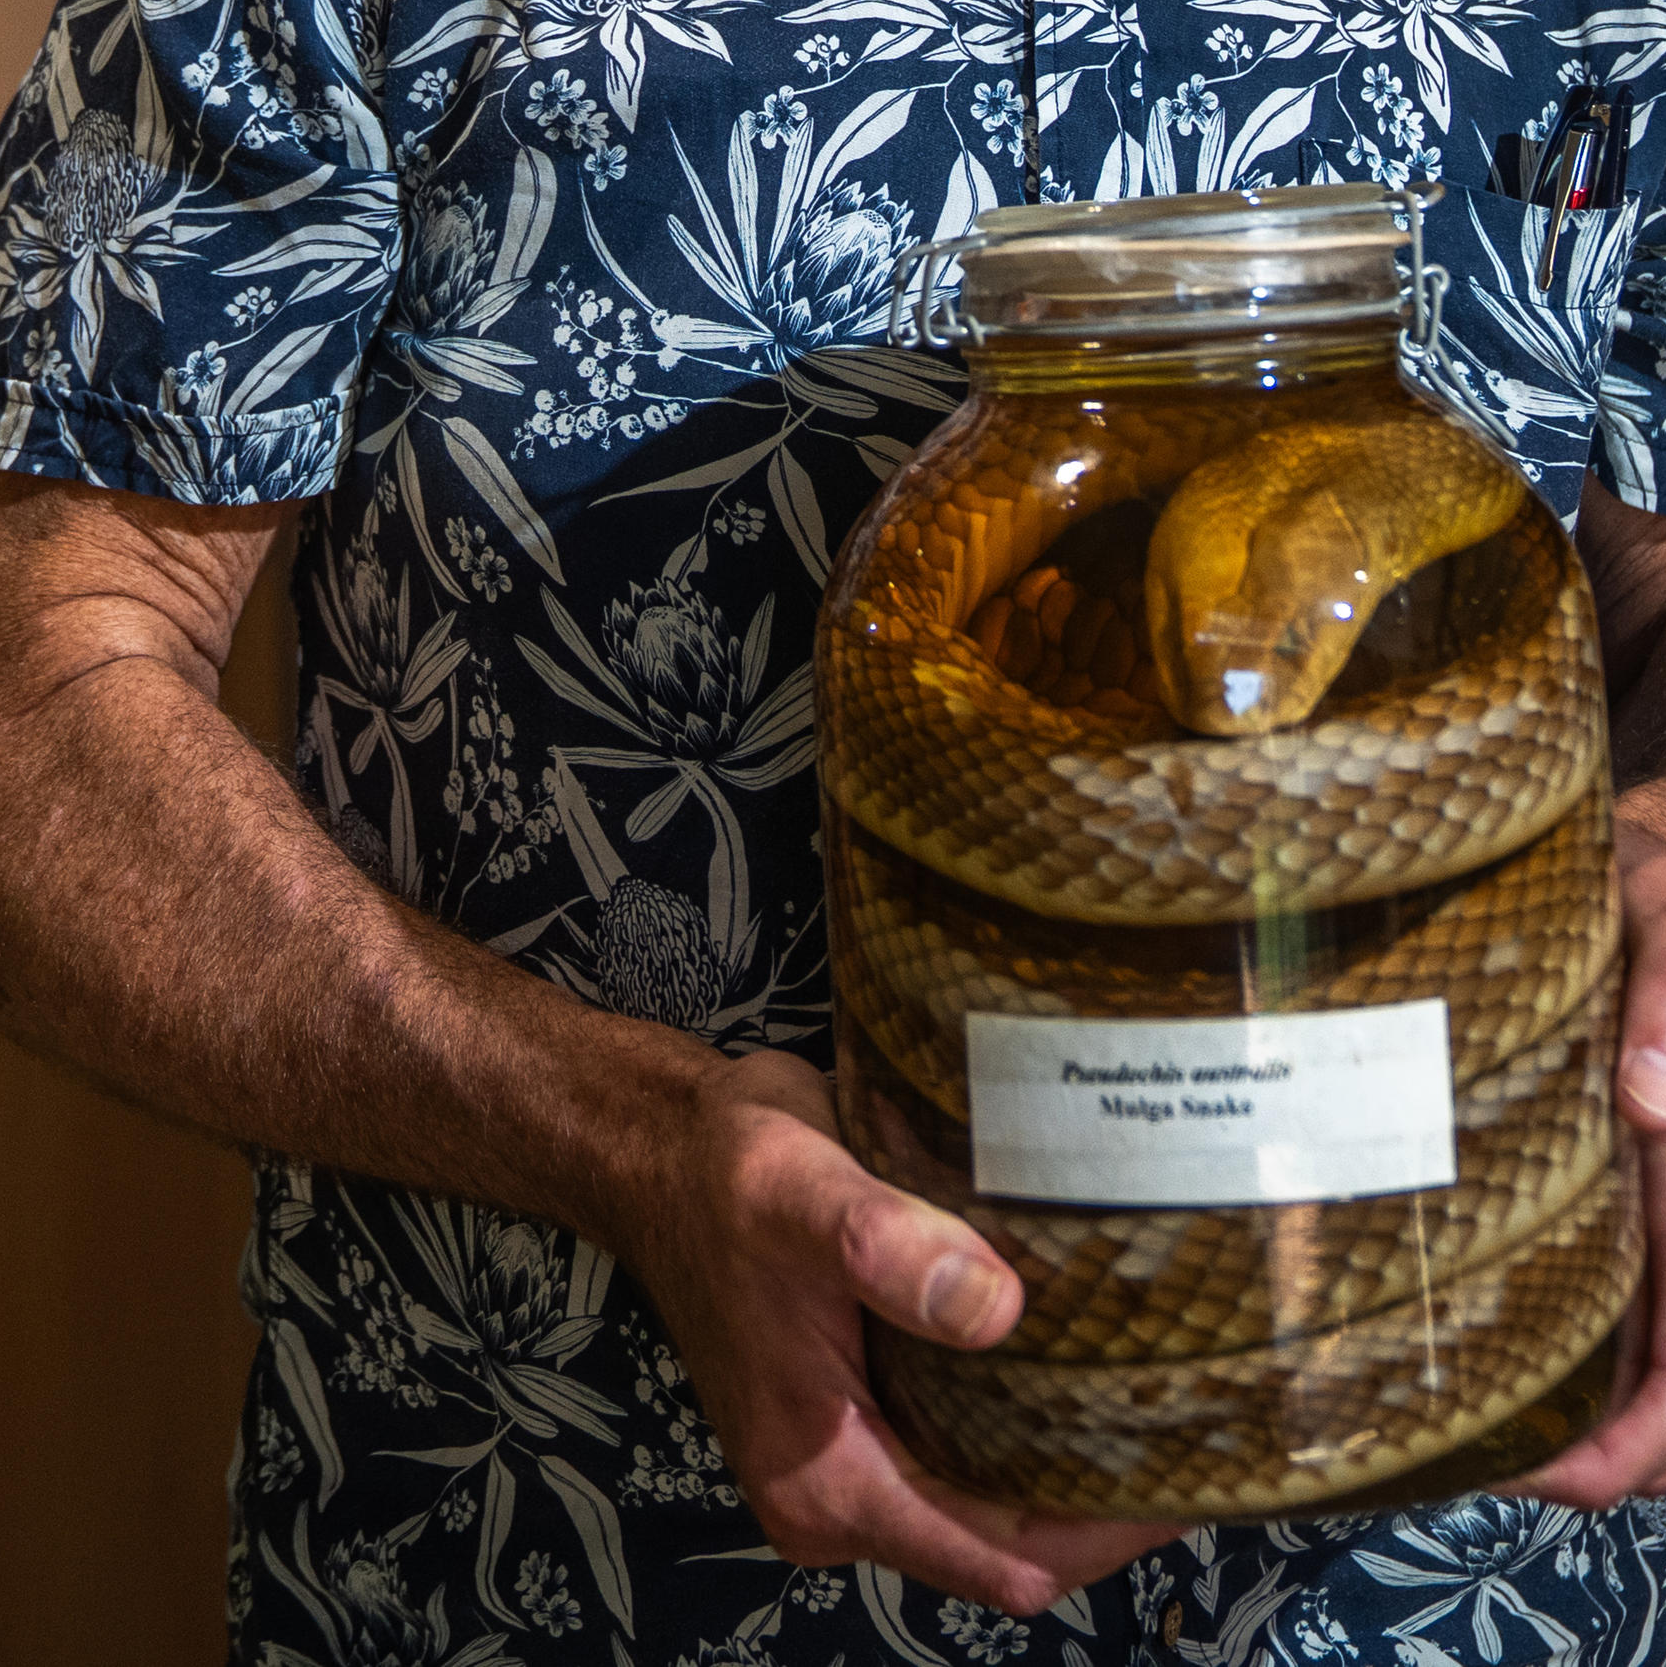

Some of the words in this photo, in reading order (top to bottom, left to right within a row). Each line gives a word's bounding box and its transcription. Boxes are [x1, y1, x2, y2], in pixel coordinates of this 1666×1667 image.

[1061, 1060, 1184, 1084] Pseudechis
[1190, 1058, 1293, 1083] australis
[1100, 1094, 1174, 1122] Mulga
[1180, 1093, 1254, 1118] Snake
